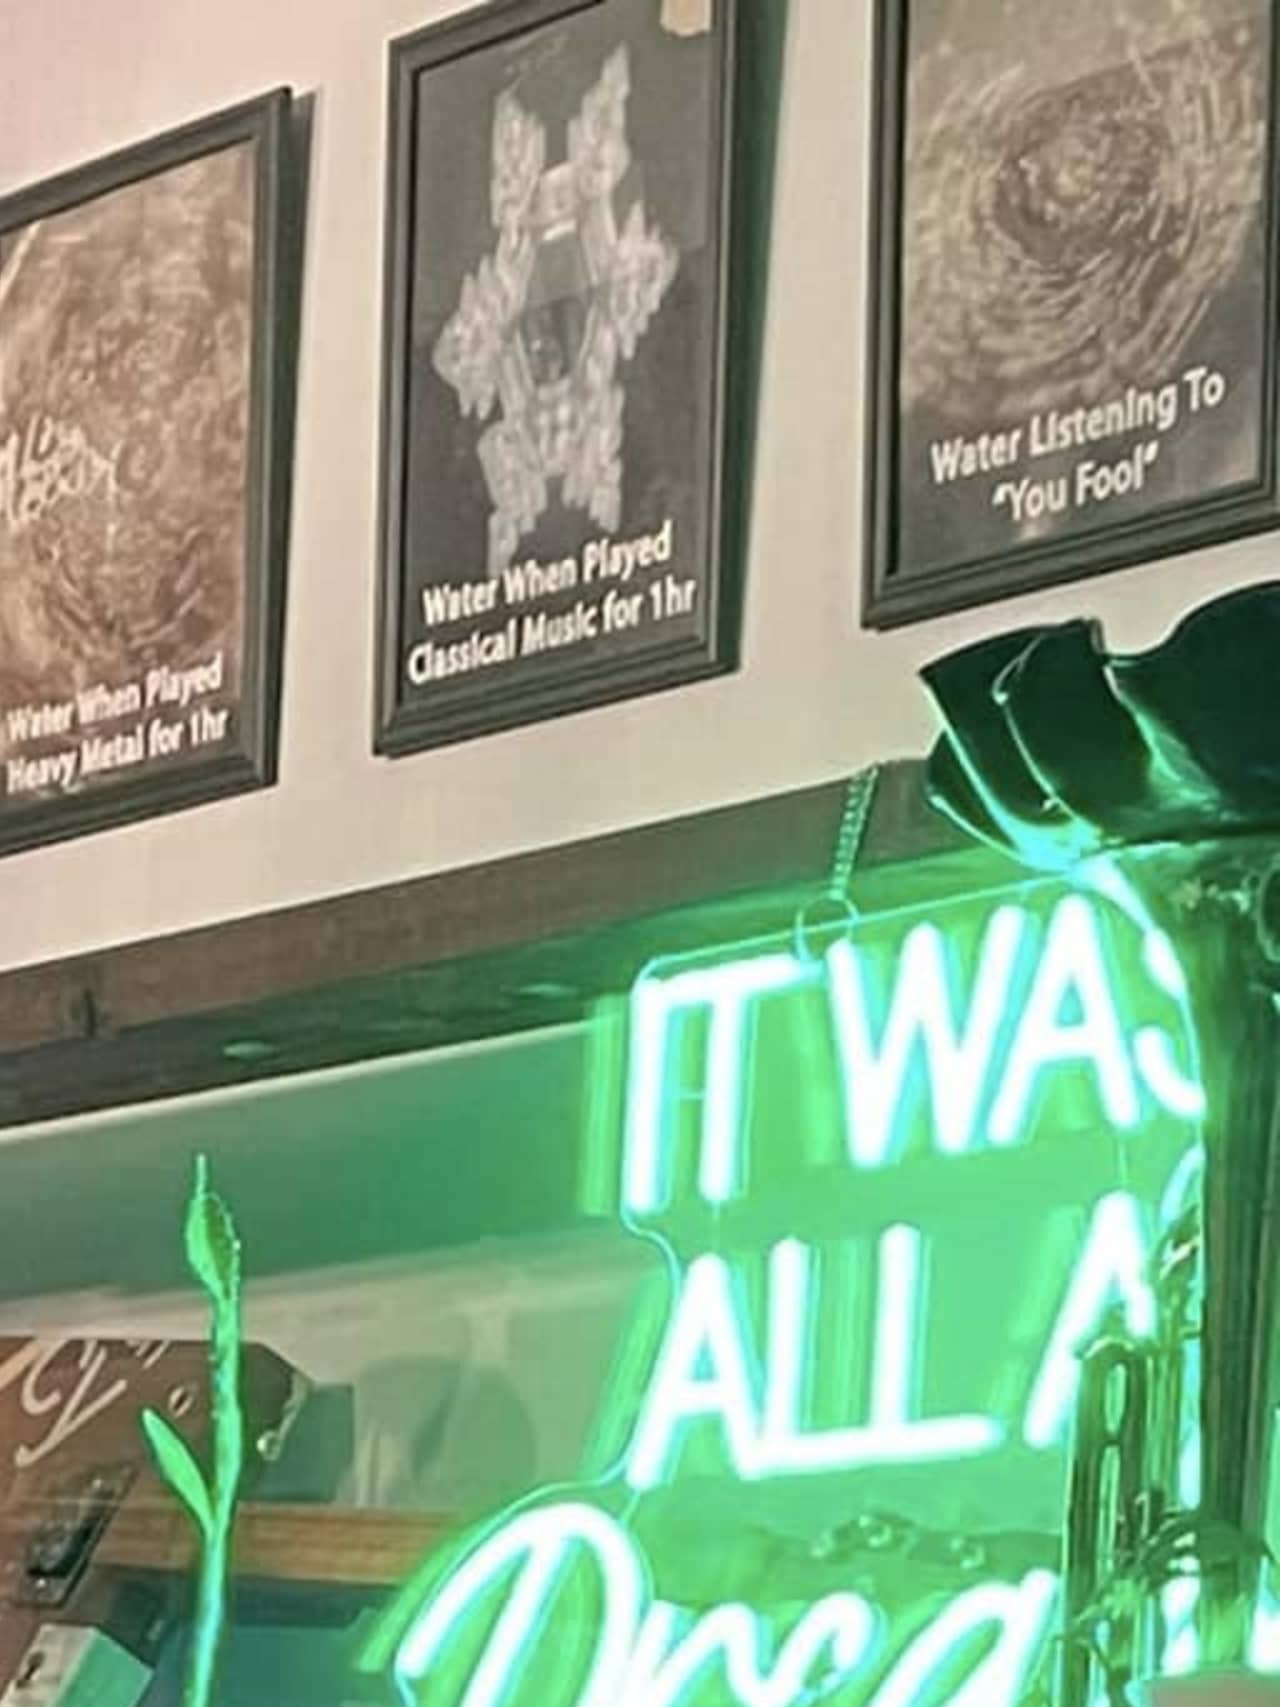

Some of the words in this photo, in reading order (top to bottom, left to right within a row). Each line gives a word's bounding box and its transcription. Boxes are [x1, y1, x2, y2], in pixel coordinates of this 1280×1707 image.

[931, 429, 1021, 484] Water
[1029, 387, 1177, 456] Listening
[1183, 366, 1225, 411] To
[423, 579, 498, 626] Water
[503, 556, 578, 604] When
[582, 518, 672, 583] Played
[408, 617, 517, 685] Classical
[520, 601, 598, 656] Music
[602, 589, 643, 633] for
[648, 573, 696, 620] 1hr
[6, 701, 74, 742] Water
[76, 682, 141, 725] When
[144, 651, 223, 708] Played
[6, 750, 78, 795] Heavy
[79, 723, 145, 775] Metal
[149, 718, 185, 757] for
[191, 704, 229, 747] 1hr
[624, 953, 825, 1211] IT
[625, 1223, 1003, 1493] ALL
